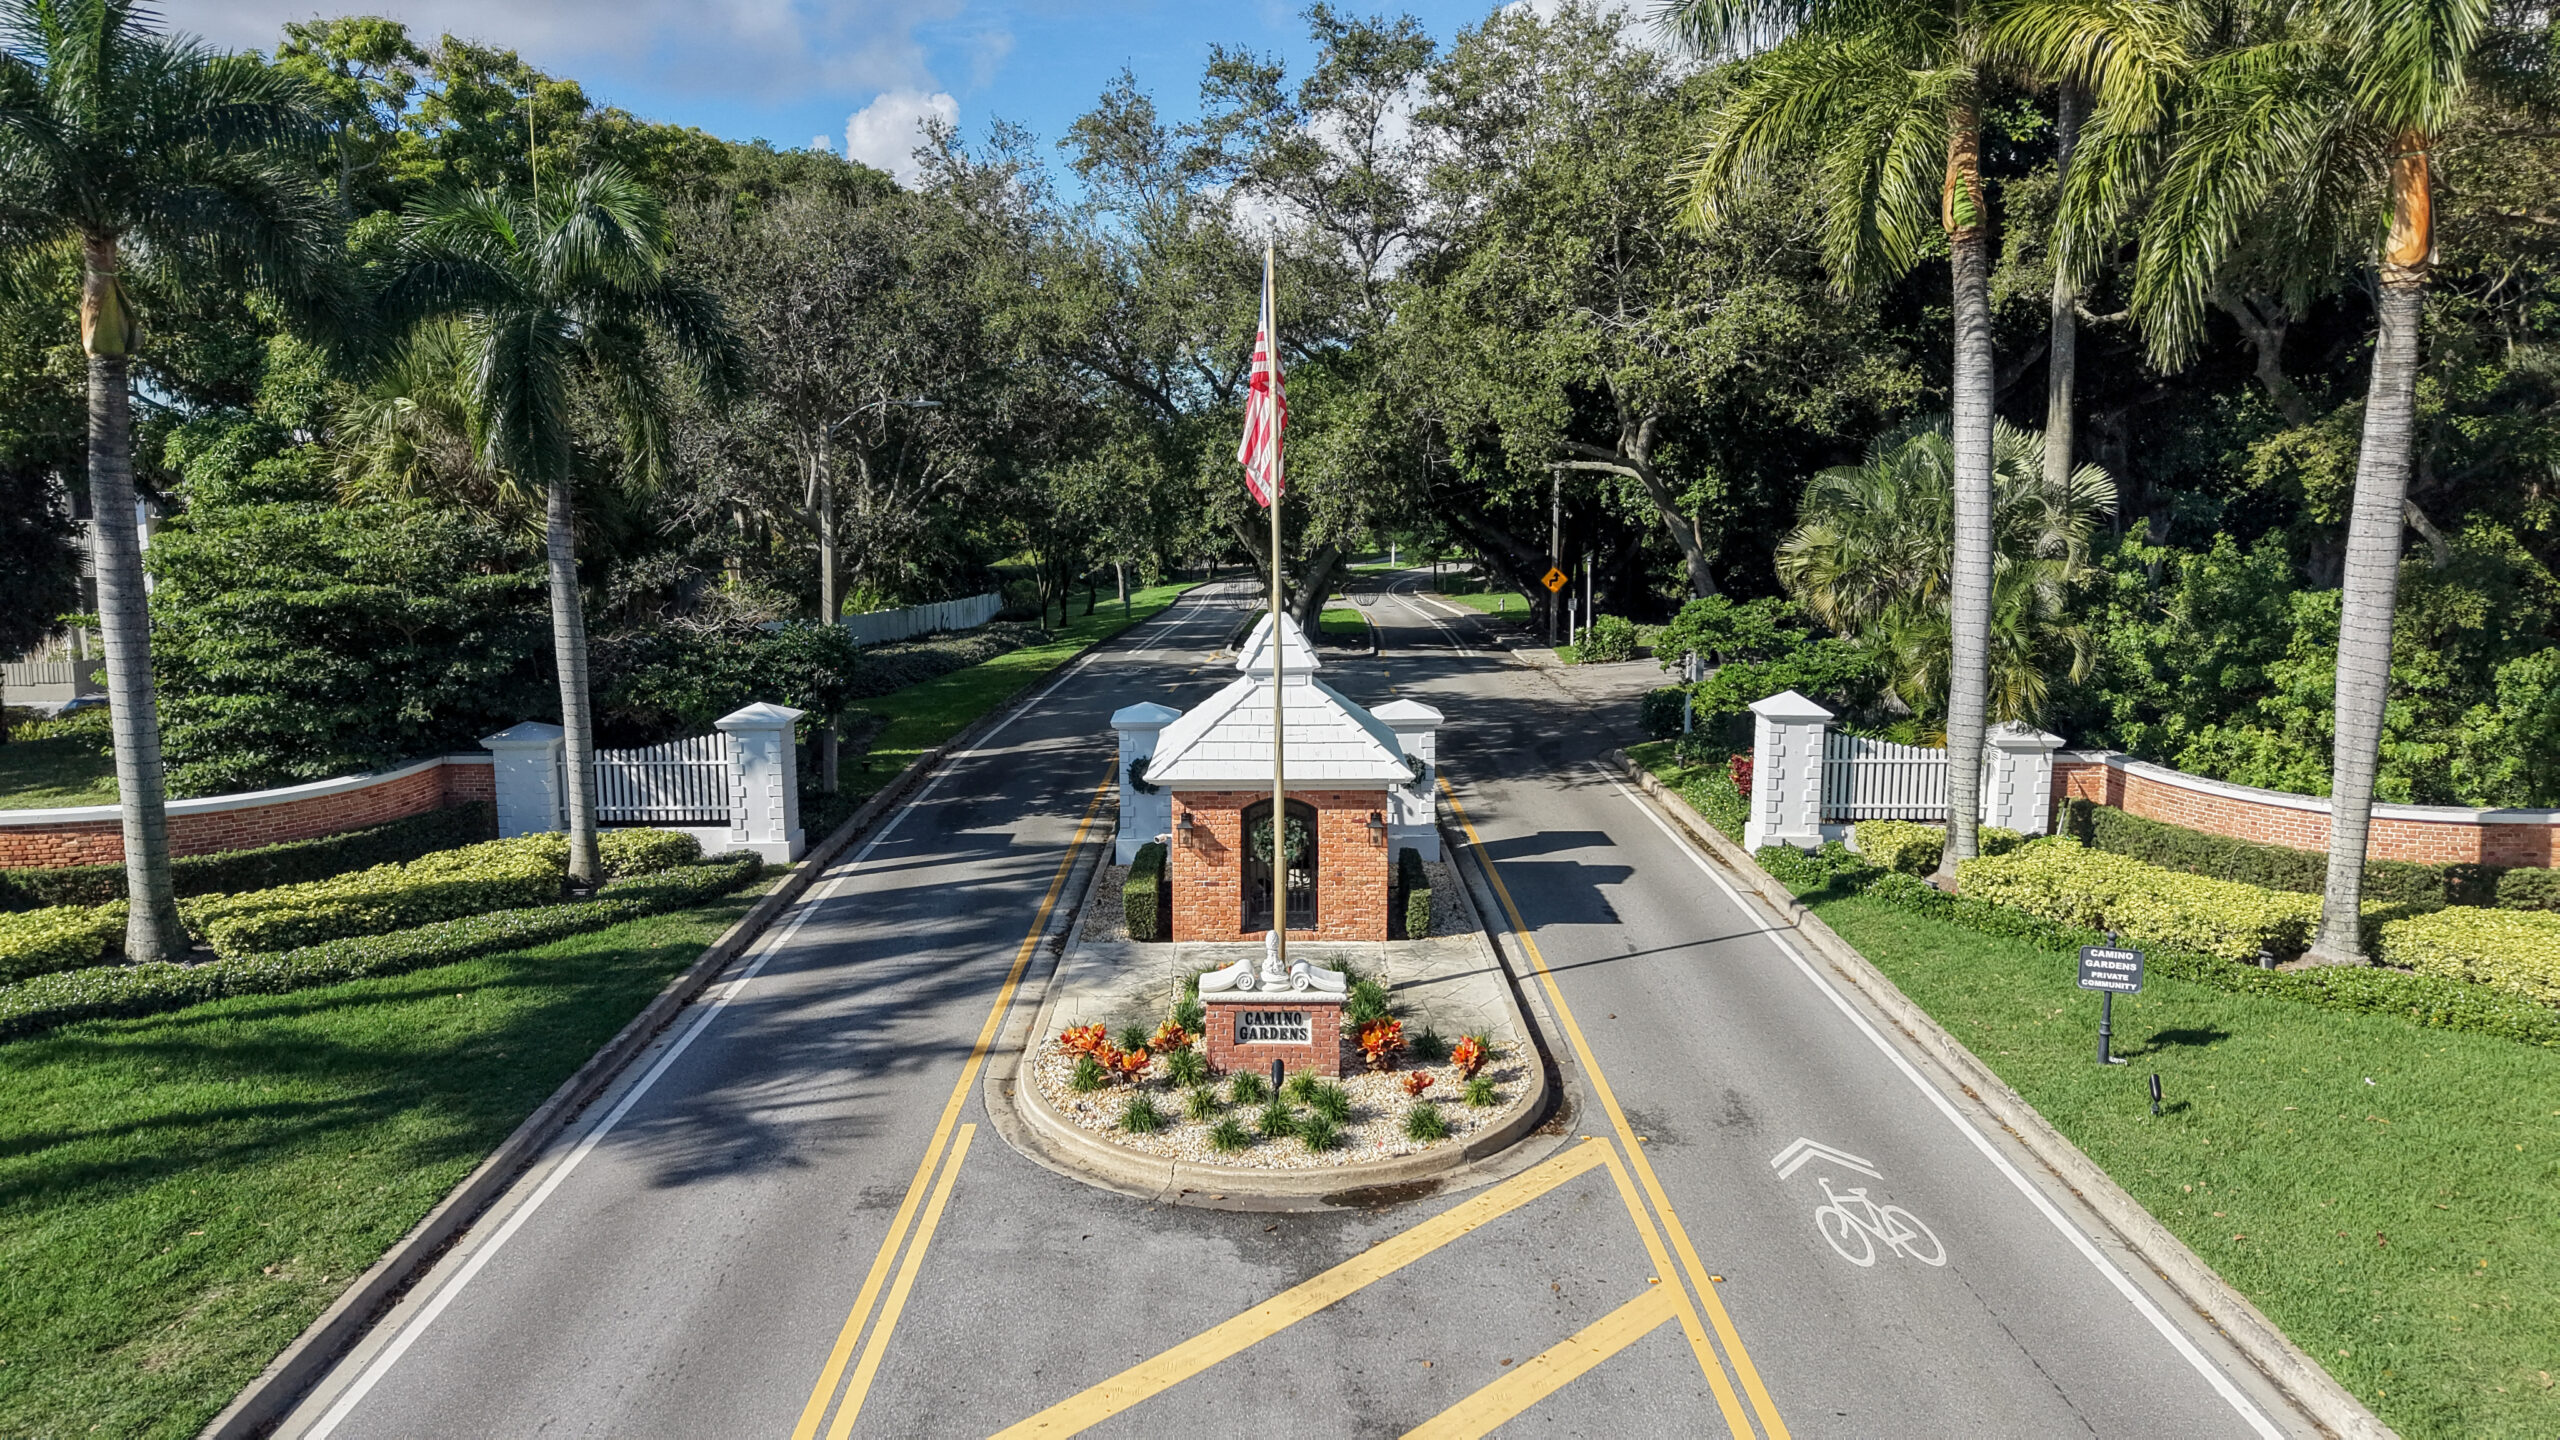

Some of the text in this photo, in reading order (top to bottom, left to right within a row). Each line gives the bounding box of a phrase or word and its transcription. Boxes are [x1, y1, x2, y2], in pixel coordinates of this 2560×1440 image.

[2090, 949, 2134, 960] CAMINO
[2085, 960, 2137, 971] GARDENS
[2091, 971, 2129, 981] PRIVATE
[2081, 979, 2137, 990] COMMUNITY
[1245, 1012, 1302, 1025] CAMINO
[1240, 1027, 1307, 1040] GARDENS
